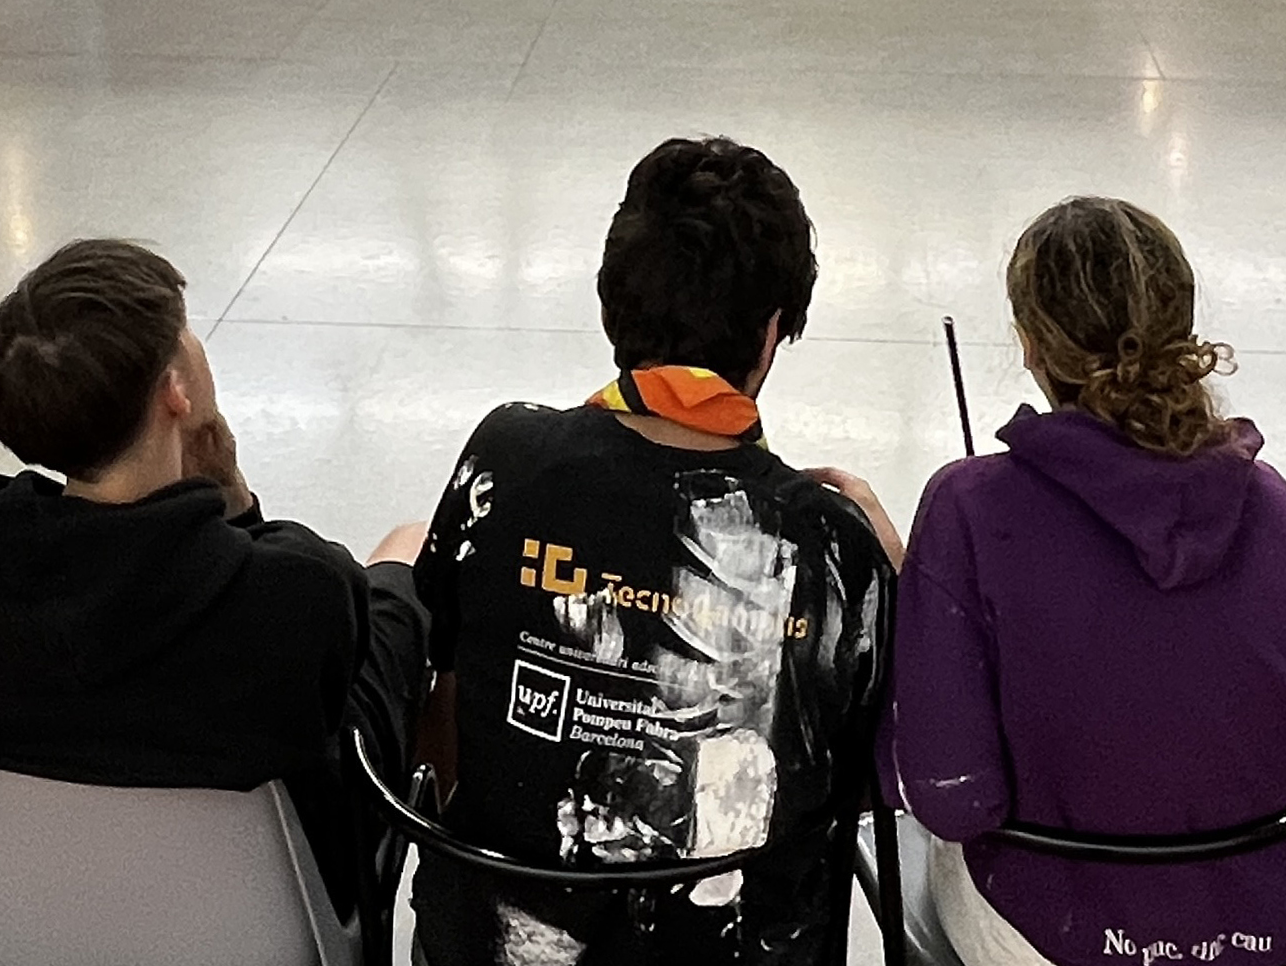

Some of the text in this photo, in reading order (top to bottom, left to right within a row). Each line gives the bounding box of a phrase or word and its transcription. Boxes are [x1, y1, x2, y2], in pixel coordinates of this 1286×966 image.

[572, 707, 632, 731] Pompeu
[569, 725, 645, 751] Barcelona
[1103, 928, 1137, 956] No
